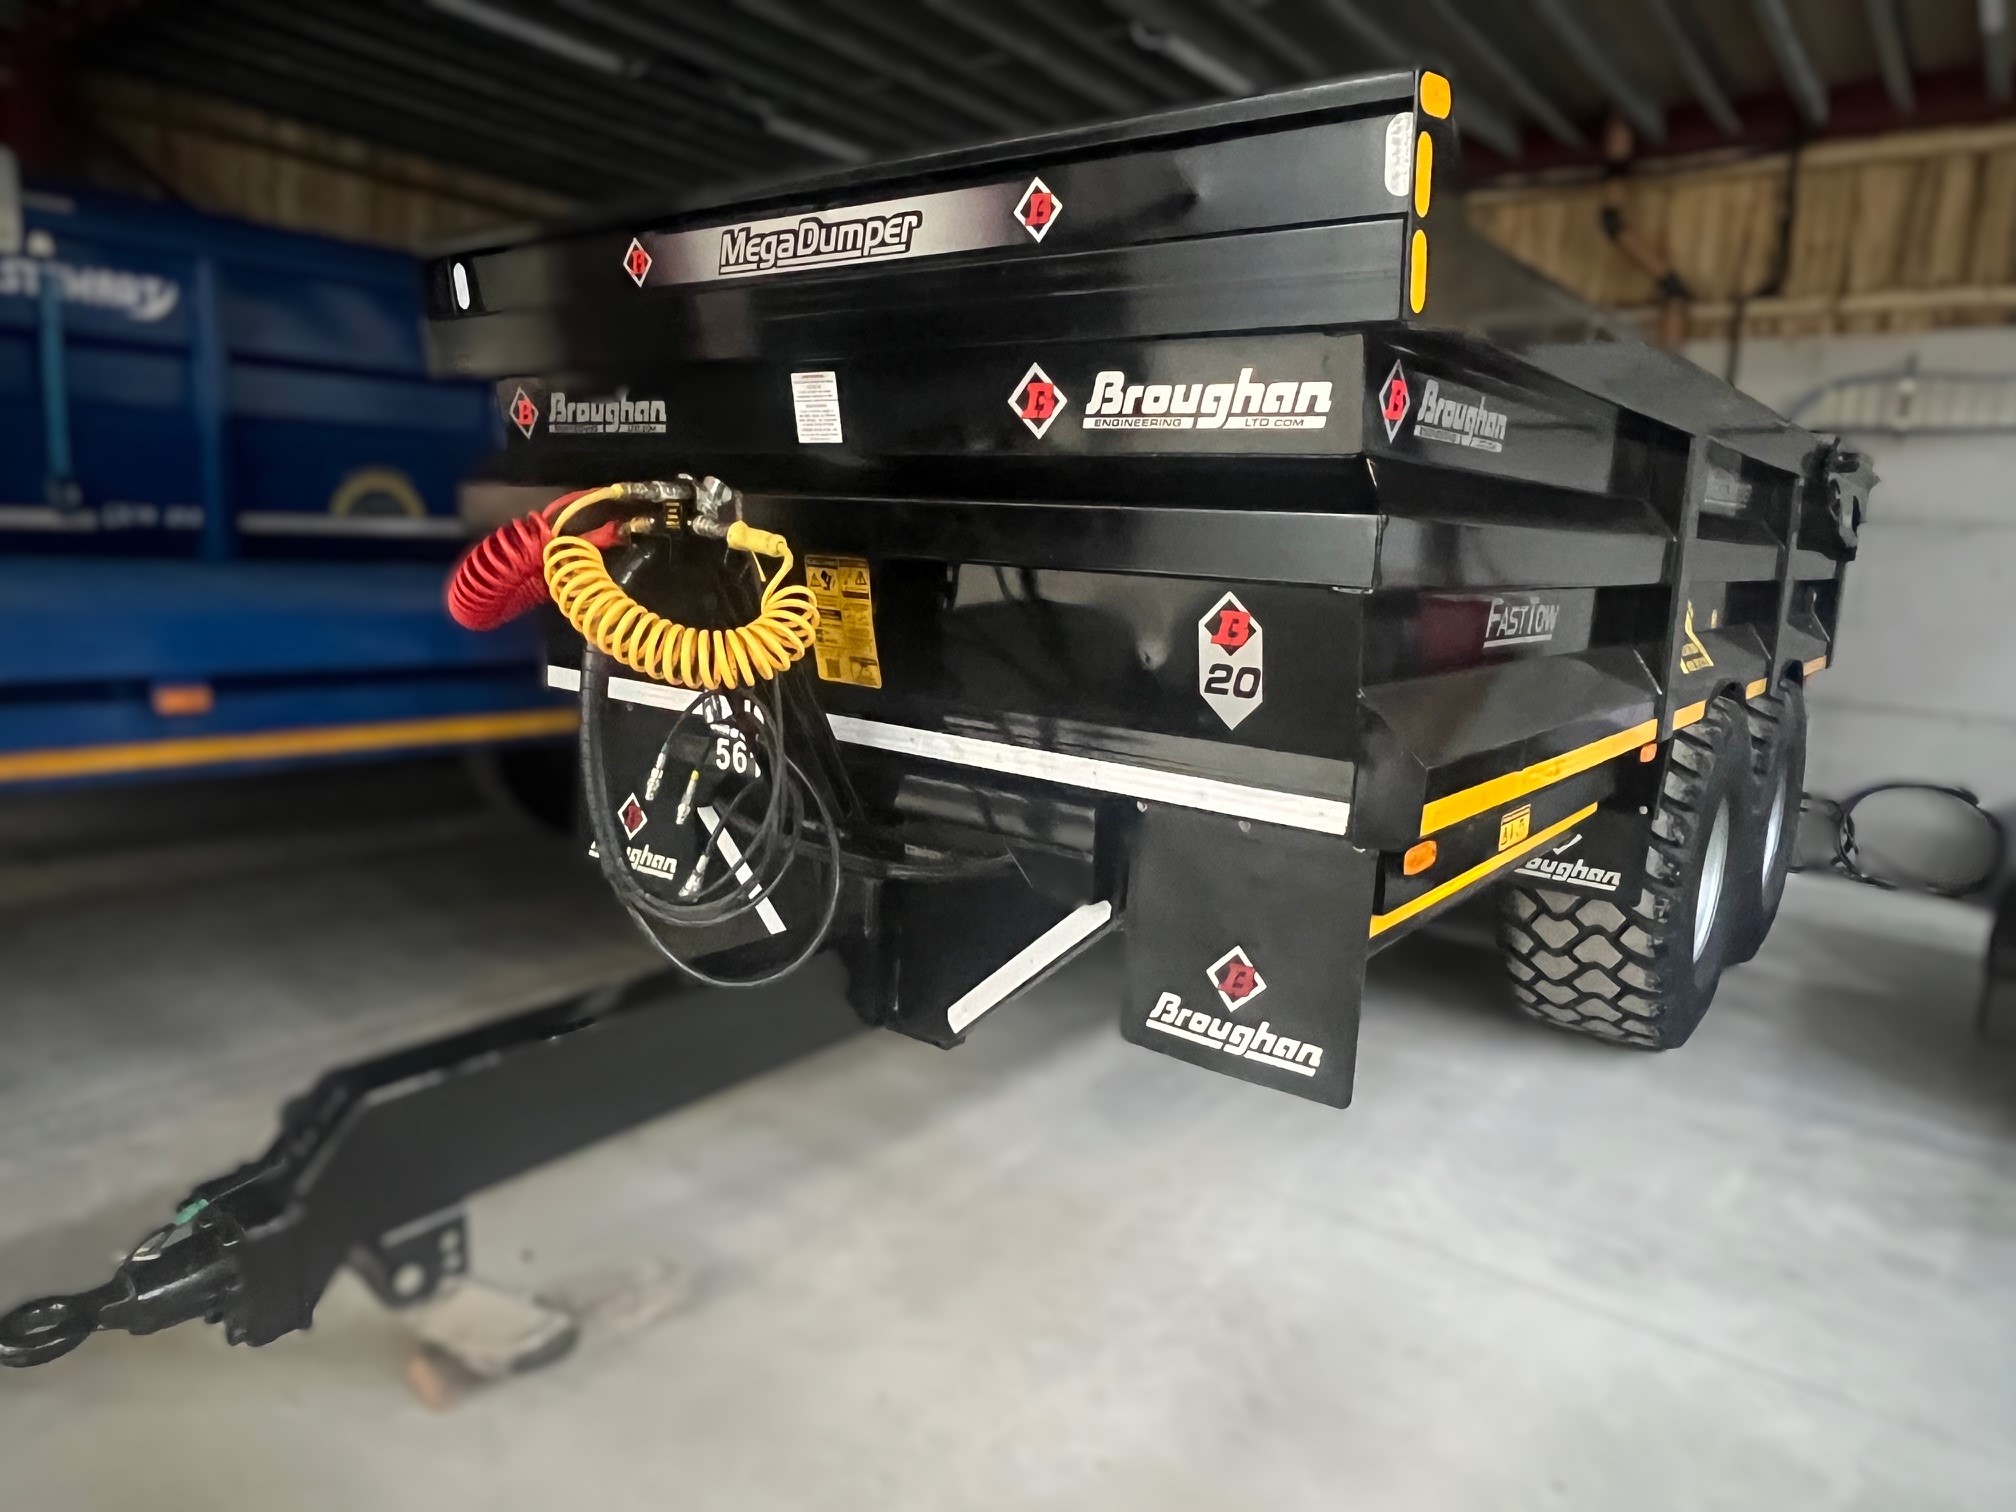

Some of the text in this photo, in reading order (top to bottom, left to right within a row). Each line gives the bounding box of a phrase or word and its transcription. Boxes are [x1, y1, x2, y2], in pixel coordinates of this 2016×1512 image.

[549, 388, 667, 433] Broughan
[1085, 368, 1332, 428] Broughan
[1417, 379, 1507, 446] Broughan
[1094, 418, 1182, 428] ENGINEERING
[1275, 418, 1304, 427] COM
[1204, 663, 1261, 699] 20
[715, 737, 762, 778] 56
[1525, 857, 1621, 885] oughan
[1149, 992, 1323, 1067] Broughan
